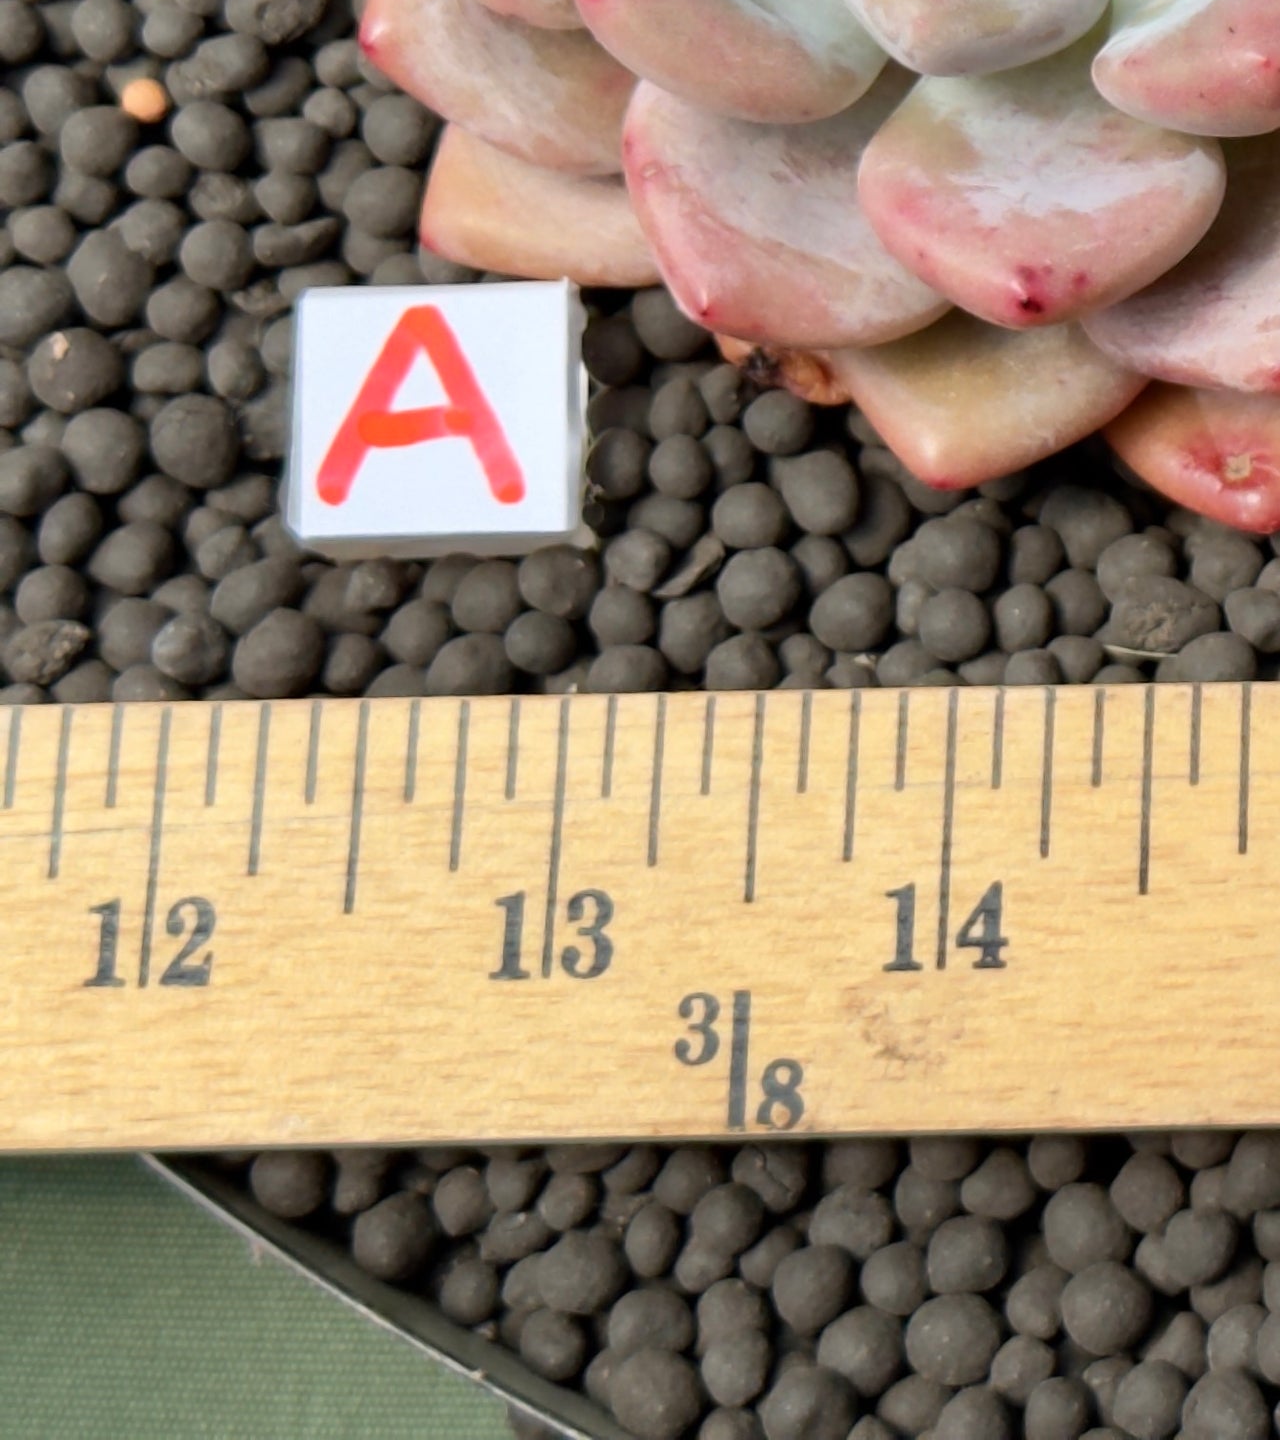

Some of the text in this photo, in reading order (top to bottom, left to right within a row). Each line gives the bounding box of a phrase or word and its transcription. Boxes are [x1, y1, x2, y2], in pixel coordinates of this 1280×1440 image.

[316, 304, 525, 506] A
[84, 897, 217, 988] 12
[488, 889, 615, 980] 13
[882, 882, 1009, 972] 14
